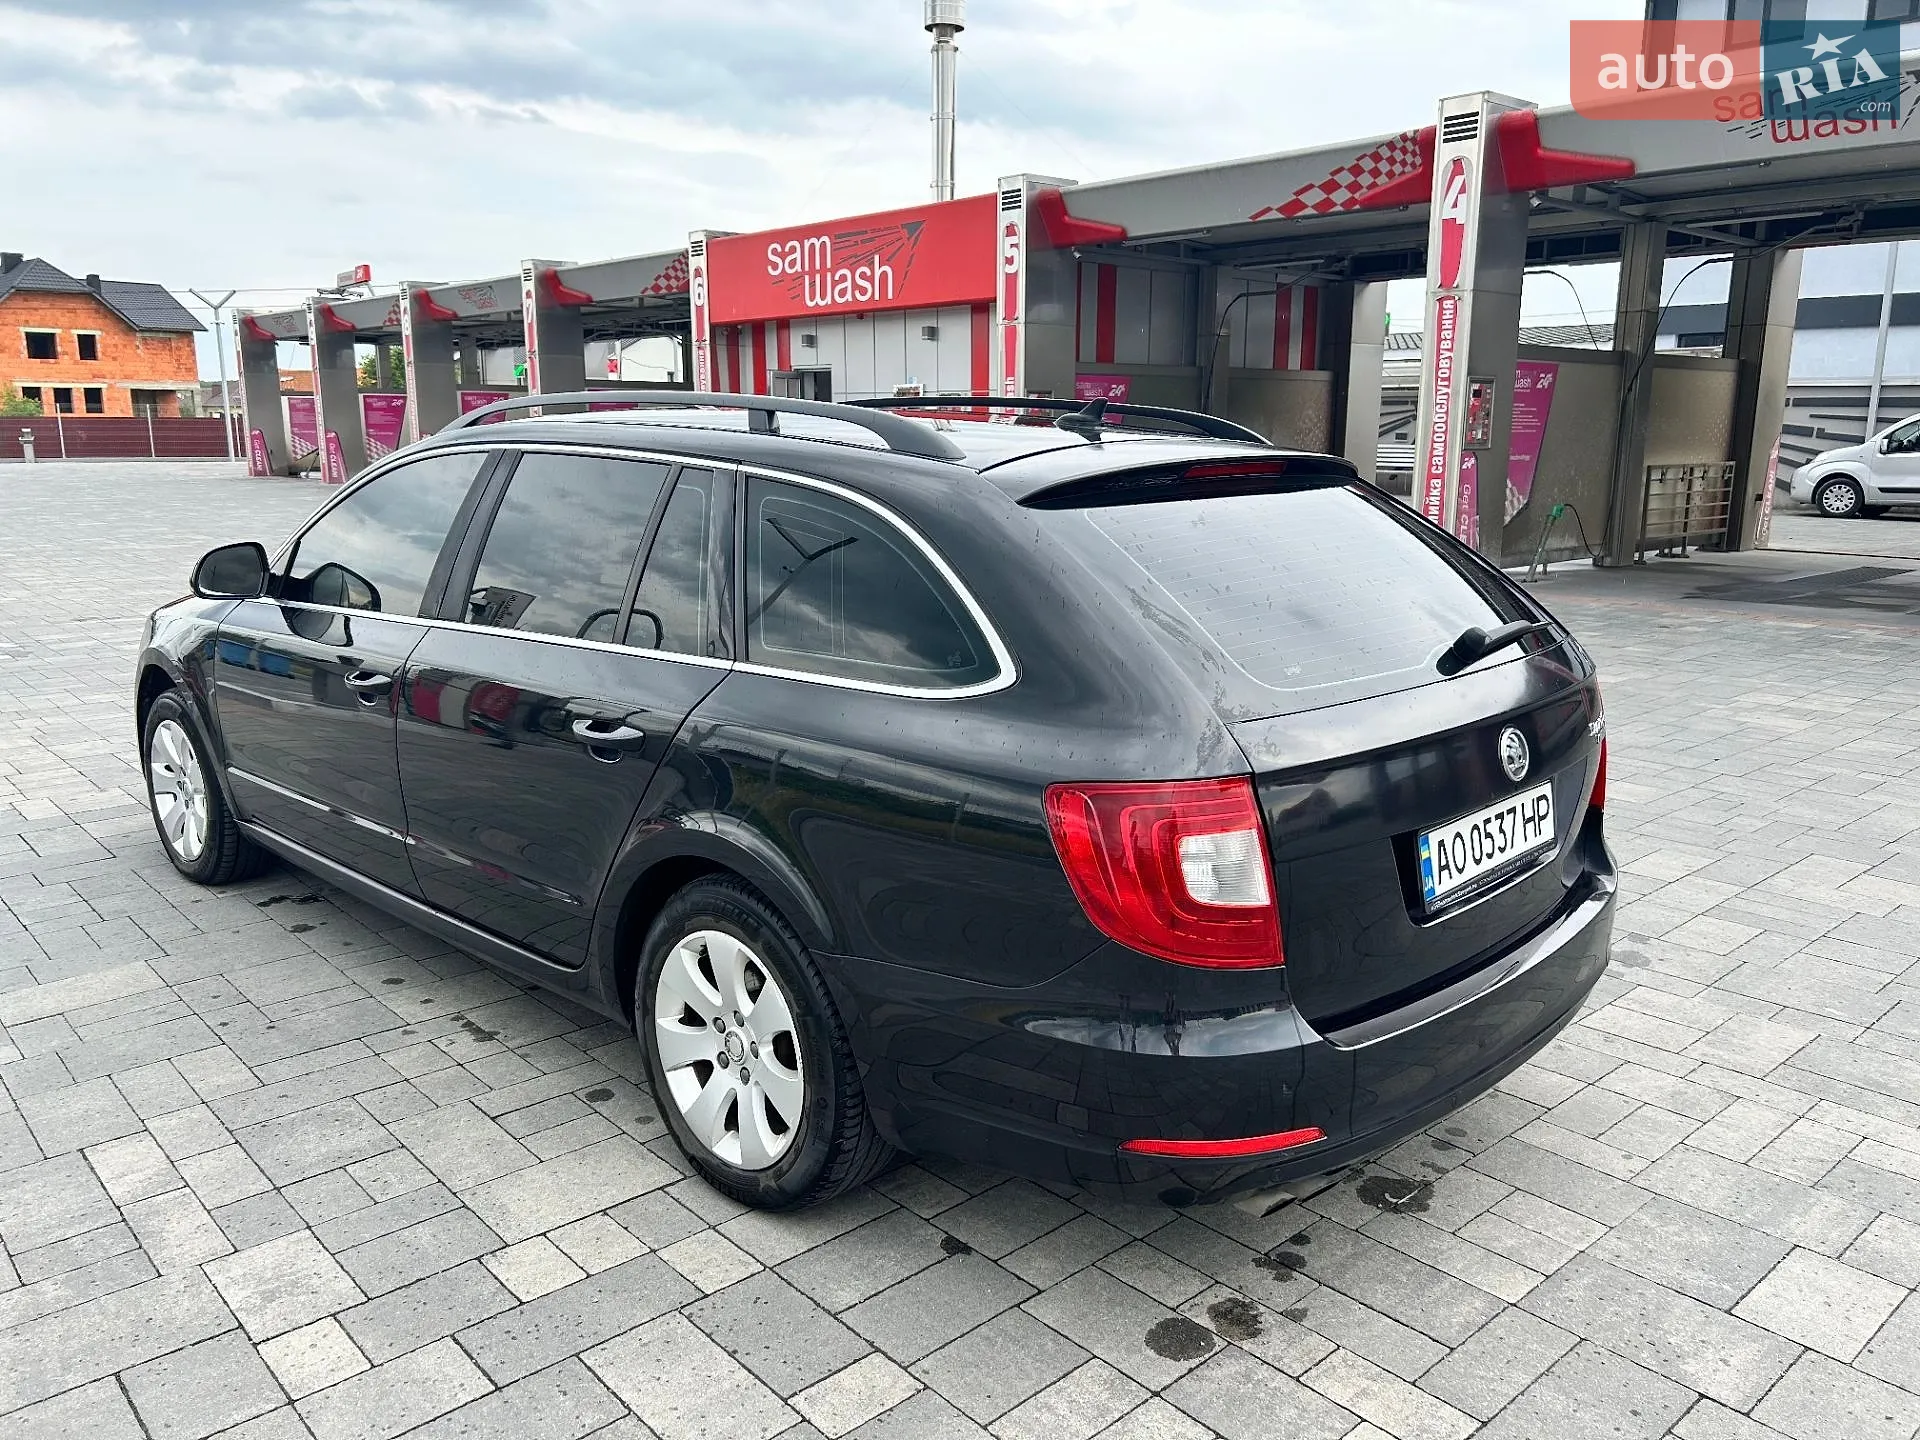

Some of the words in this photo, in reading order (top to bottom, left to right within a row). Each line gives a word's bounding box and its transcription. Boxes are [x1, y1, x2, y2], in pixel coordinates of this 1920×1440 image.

[1770, 96, 1897, 143] wash
[1442, 174, 1467, 225] 4
[767, 235, 831, 276] sam
[1004, 235, 1020, 275] 5
[694, 276, 705, 307] 6
[804, 254, 893, 307] wash
[1431, 300, 1455, 474] самообслуговування
[1459, 514, 1469, 544] CLE
[1438, 831, 1467, 885] AO
[1470, 806, 1517, 865] 0537
[1522, 794, 1550, 842] HP
